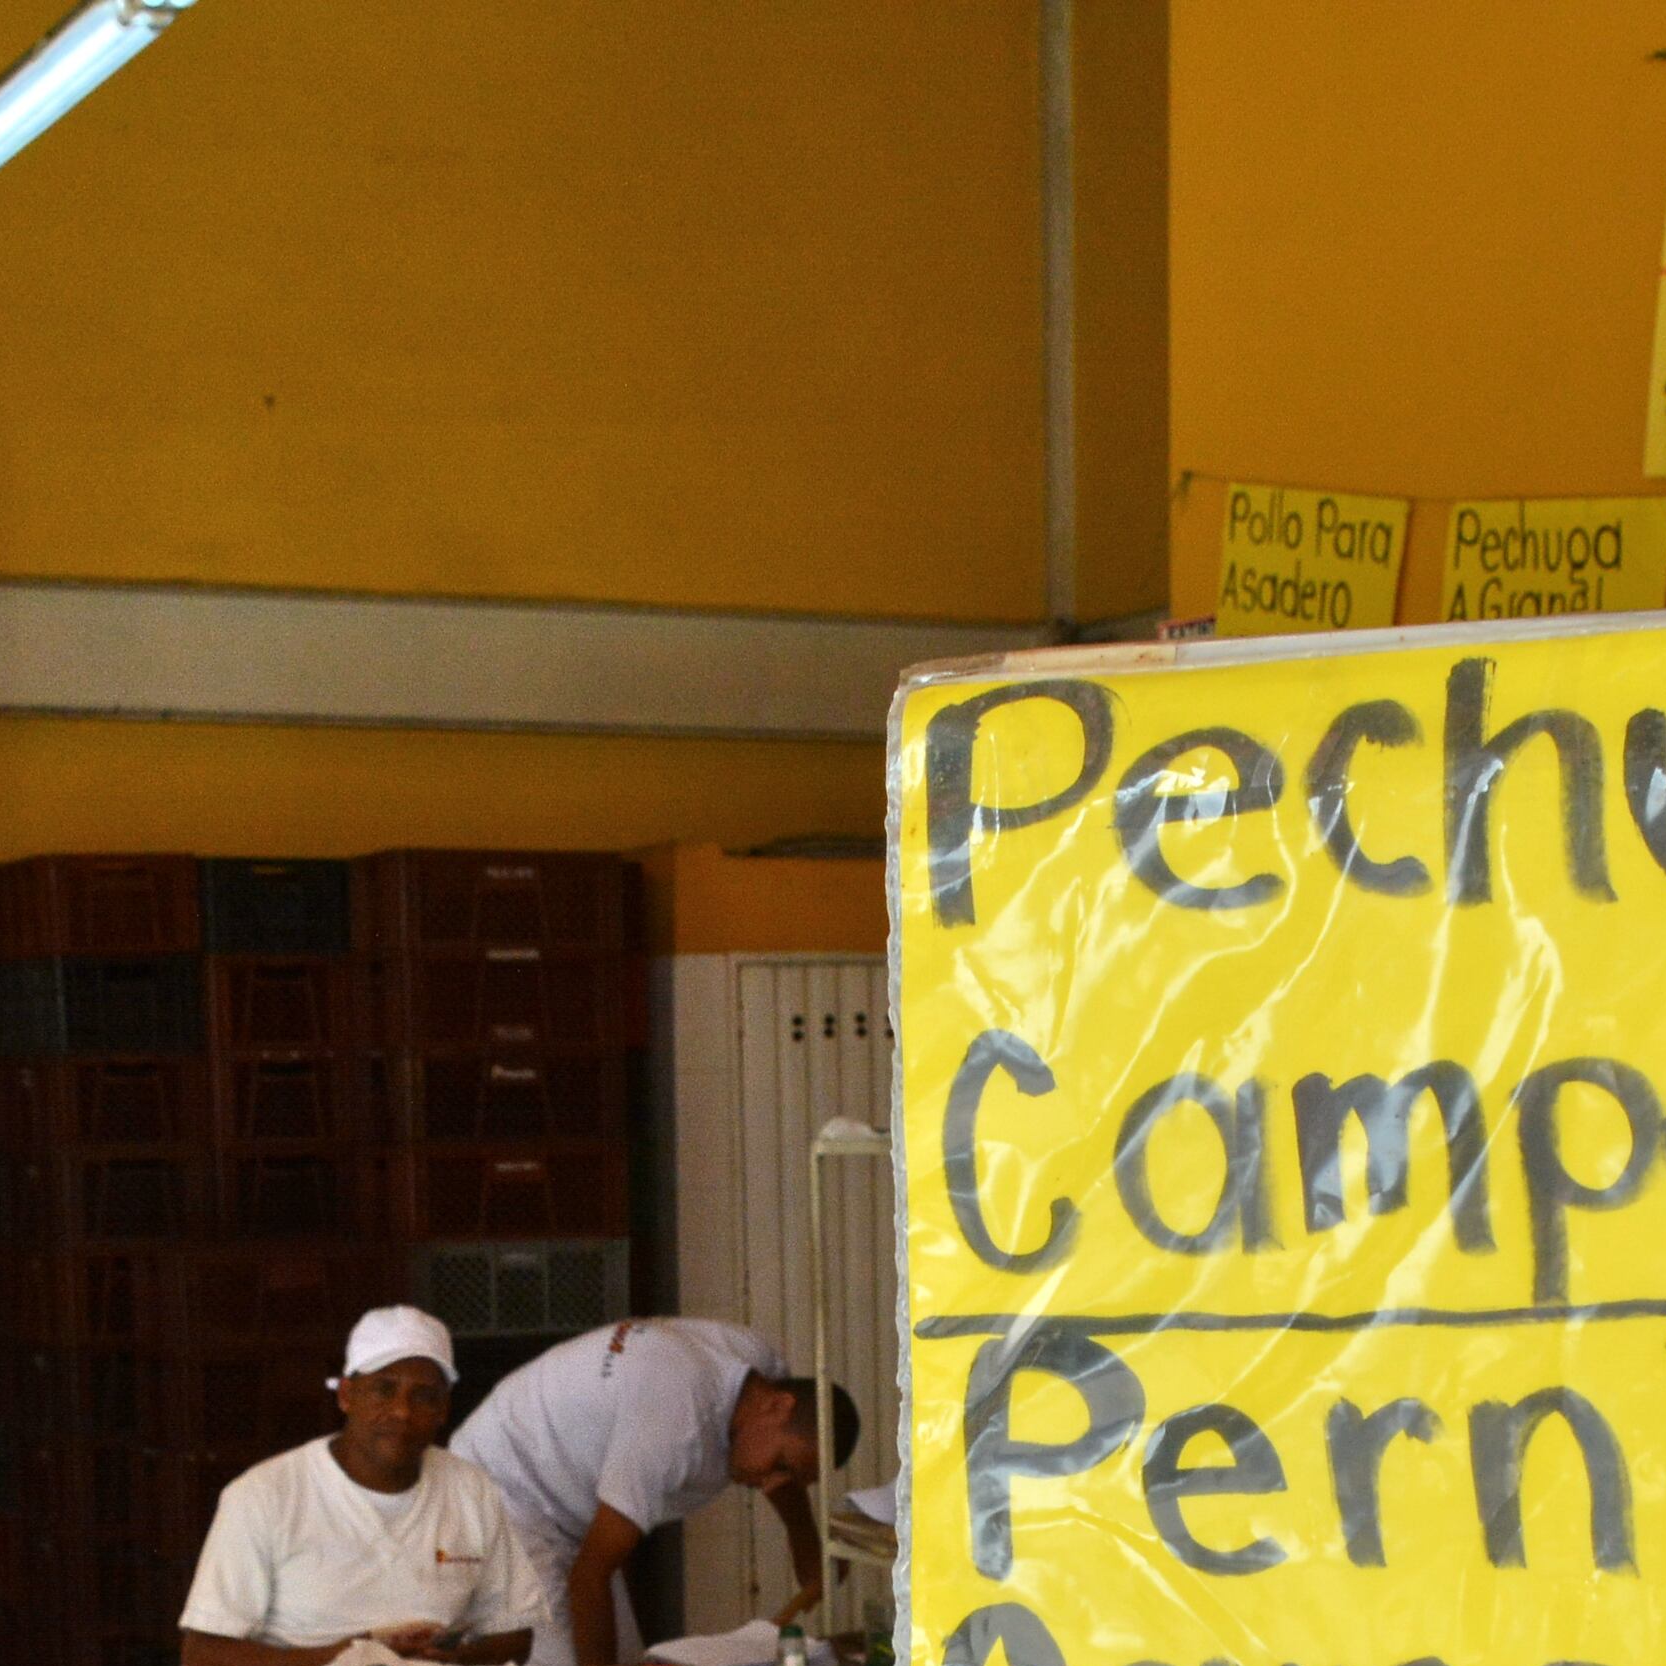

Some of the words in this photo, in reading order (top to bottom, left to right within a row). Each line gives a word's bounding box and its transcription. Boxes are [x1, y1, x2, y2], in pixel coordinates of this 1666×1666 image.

[1227, 490, 1304, 550] Pollo
[1316, 496, 1395, 570] Para
[1453, 500, 1623, 587] Pechuga
[1220, 559, 1353, 630] Asadero
[1445, 582, 1468, 623] A
